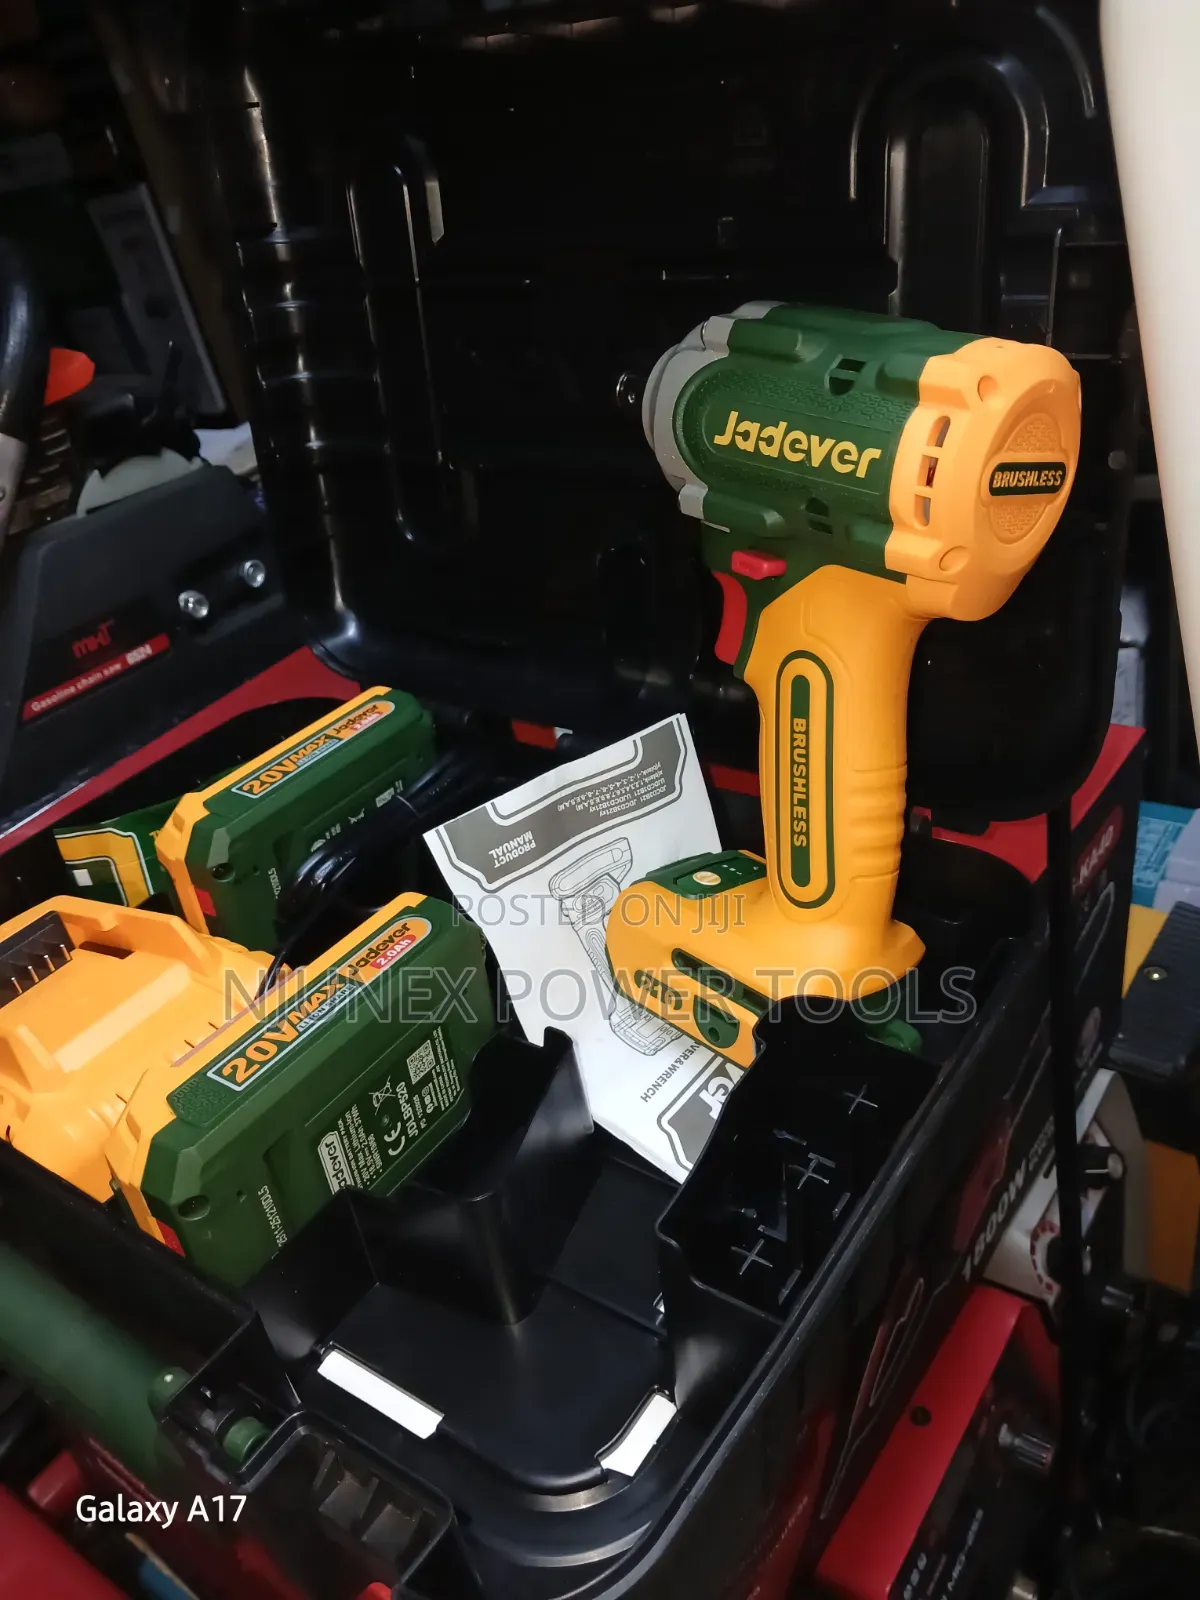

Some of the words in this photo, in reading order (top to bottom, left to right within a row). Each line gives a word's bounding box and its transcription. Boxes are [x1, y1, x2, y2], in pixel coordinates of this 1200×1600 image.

[714, 410, 882, 479] Jadever
[992, 469, 1063, 489] BRUSHLESS
[31, 686, 77, 712] Gasoline
[793, 717, 807, 847] BRUSHLESS
[488, 830, 533, 859] MANUAL
[493, 839, 537, 869] PRODUCT
[348, 922, 411, 976] Jadever
[376, 937, 412, 966] 2.0Ah
[396, 1081, 418, 1137] JDLBP520
